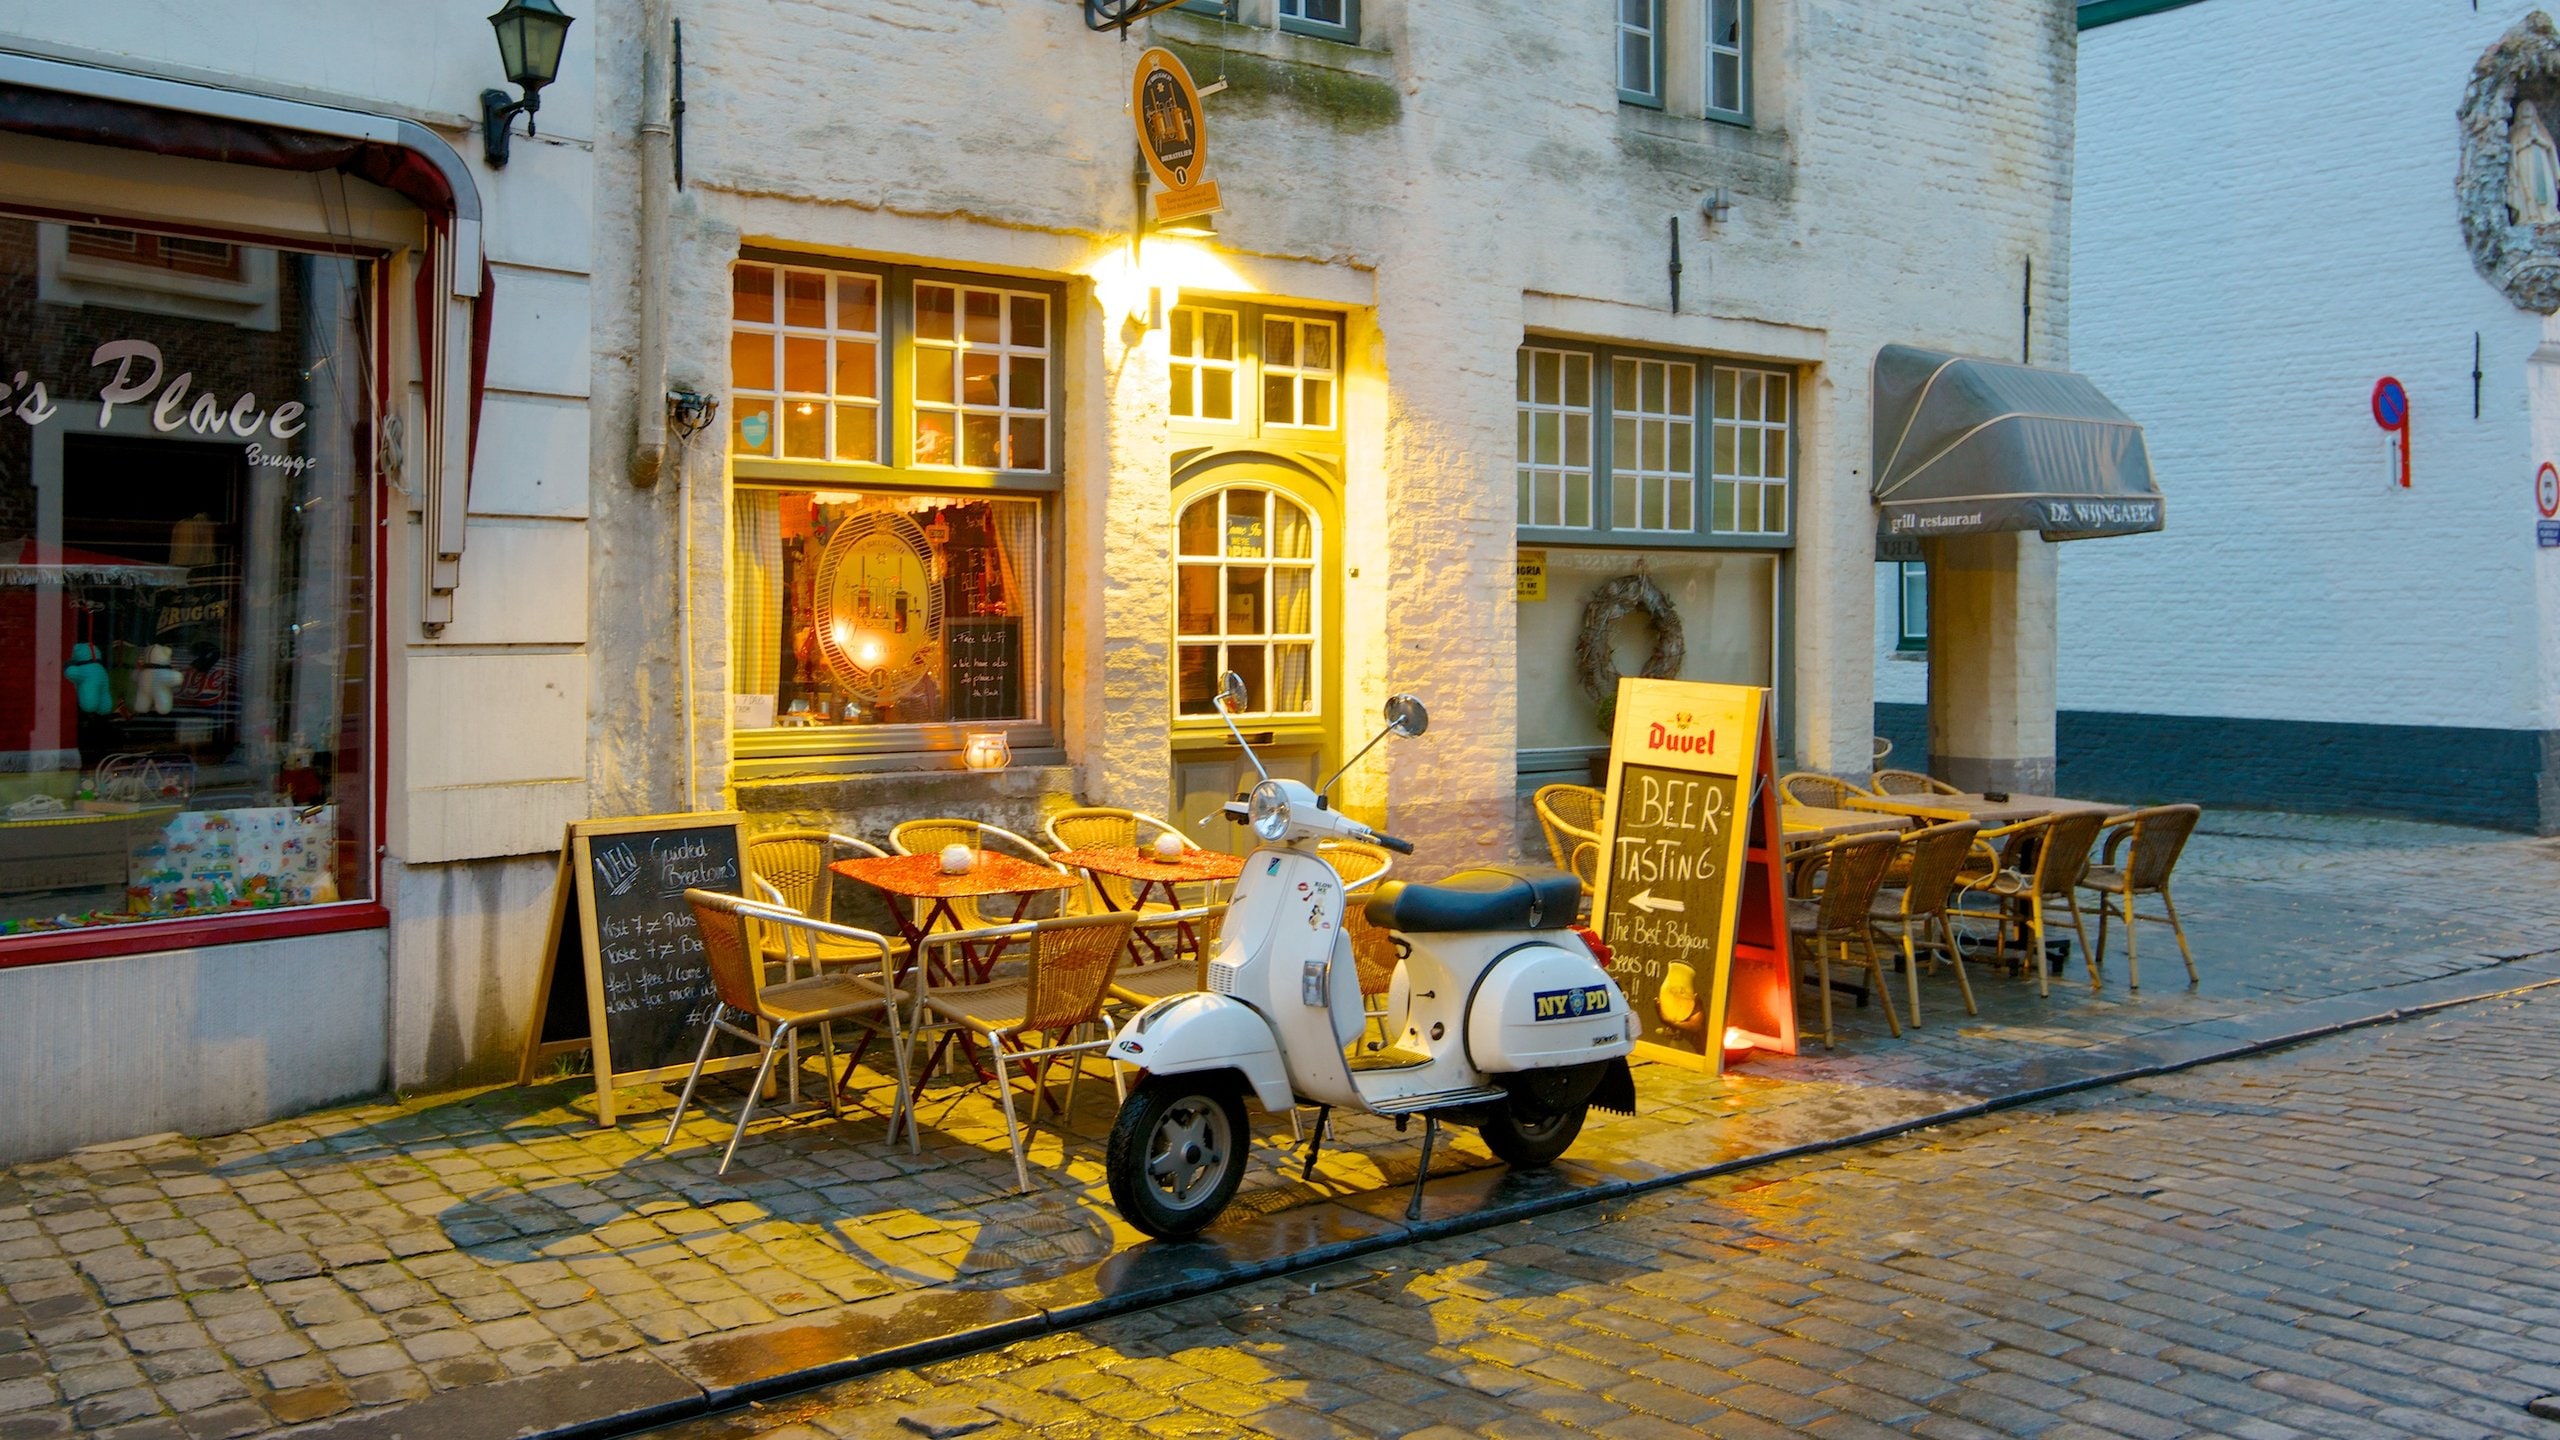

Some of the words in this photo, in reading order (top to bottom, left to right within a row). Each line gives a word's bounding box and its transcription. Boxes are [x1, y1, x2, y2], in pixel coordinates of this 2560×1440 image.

[1178, 170, 1185, 183] 1
[91, 339, 306, 439] Place
[245, 443, 316, 477] Brugge
[1891, 513, 1916, 534] grill
[1920, 512, 1983, 528] restaurant
[2050, 503, 2072, 521] DE
[2074, 503, 2156, 528] WIJNGAERT
[956, 631, 975, 643] Free
[1649, 722, 1715, 755] Duvel
[595, 842, 637, 888] NEW
[650, 837, 711, 862] Guided
[602, 915, 629, 937] Visit
[632, 915, 642, 936] 7
[663, 911, 697, 934] Pubs
[1608, 912, 1629, 942] The
[1634, 916, 1661, 945] Best
[1664, 920, 1710, 959] Belgian
[601, 943, 641, 964] Taste
[645, 940, 656, 958] 7
[606, 972, 632, 1000] feel
[636, 967, 664, 993] free
